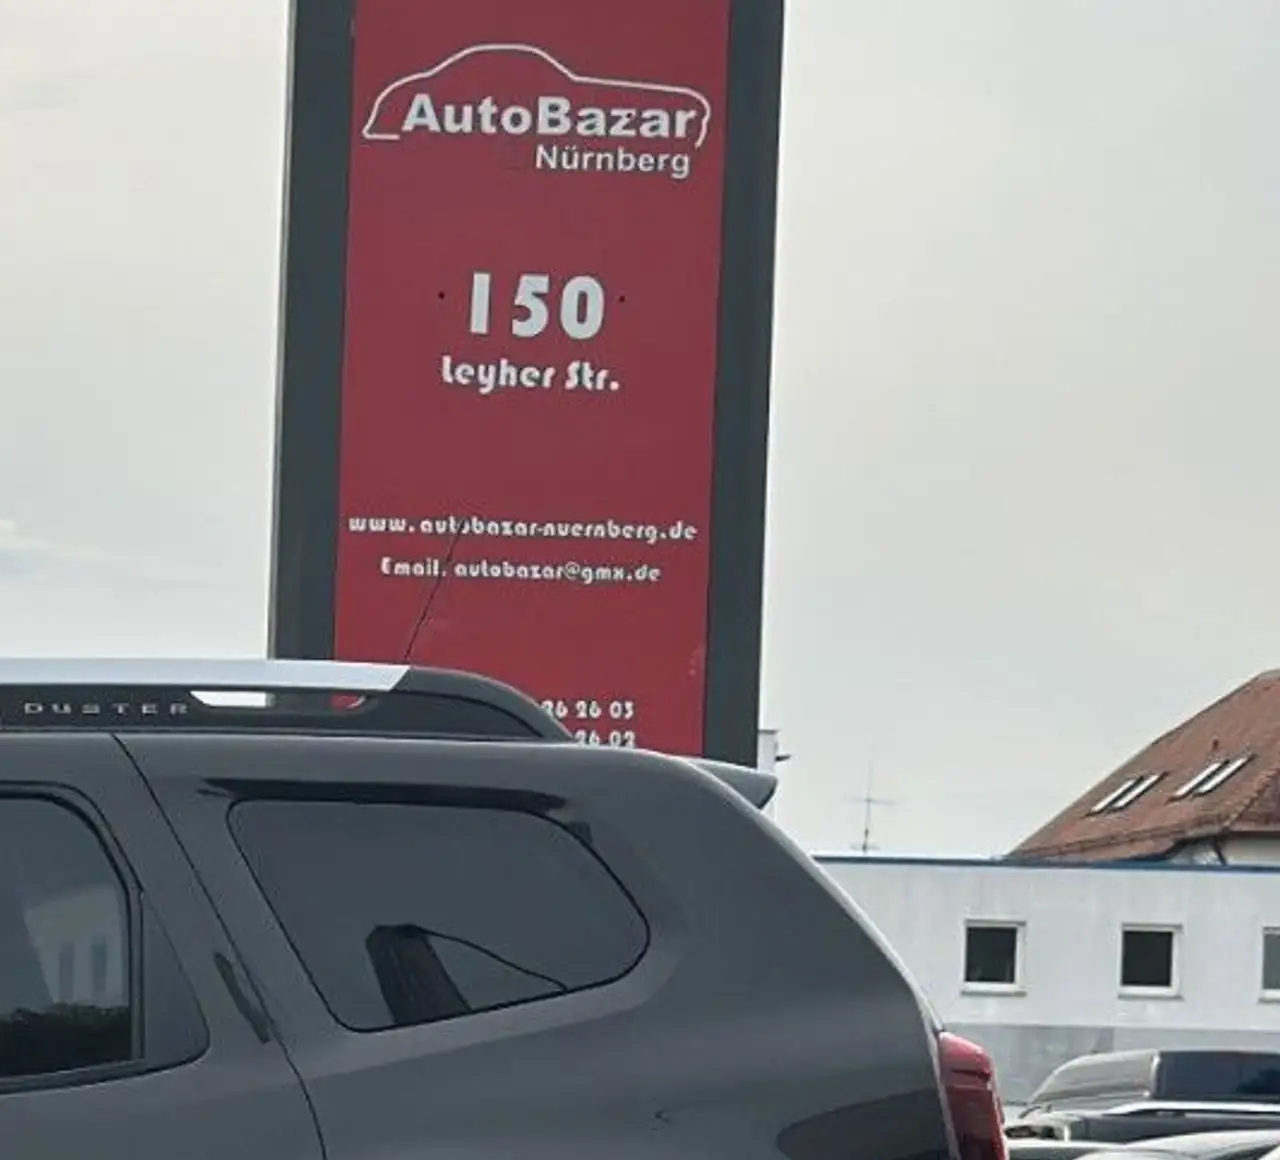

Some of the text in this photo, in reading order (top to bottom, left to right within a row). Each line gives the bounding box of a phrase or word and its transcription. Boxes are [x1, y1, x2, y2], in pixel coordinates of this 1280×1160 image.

[401, 93, 697, 139] AutoBazar
[535, 145, 691, 180] Nürnberg
[469, 272, 605, 340] 150
[441, 355, 621, 395] Leyher Str.
[454, 560, 661, 584] autobazar@gmx.de
[23, 701, 188, 715] DUSTER
